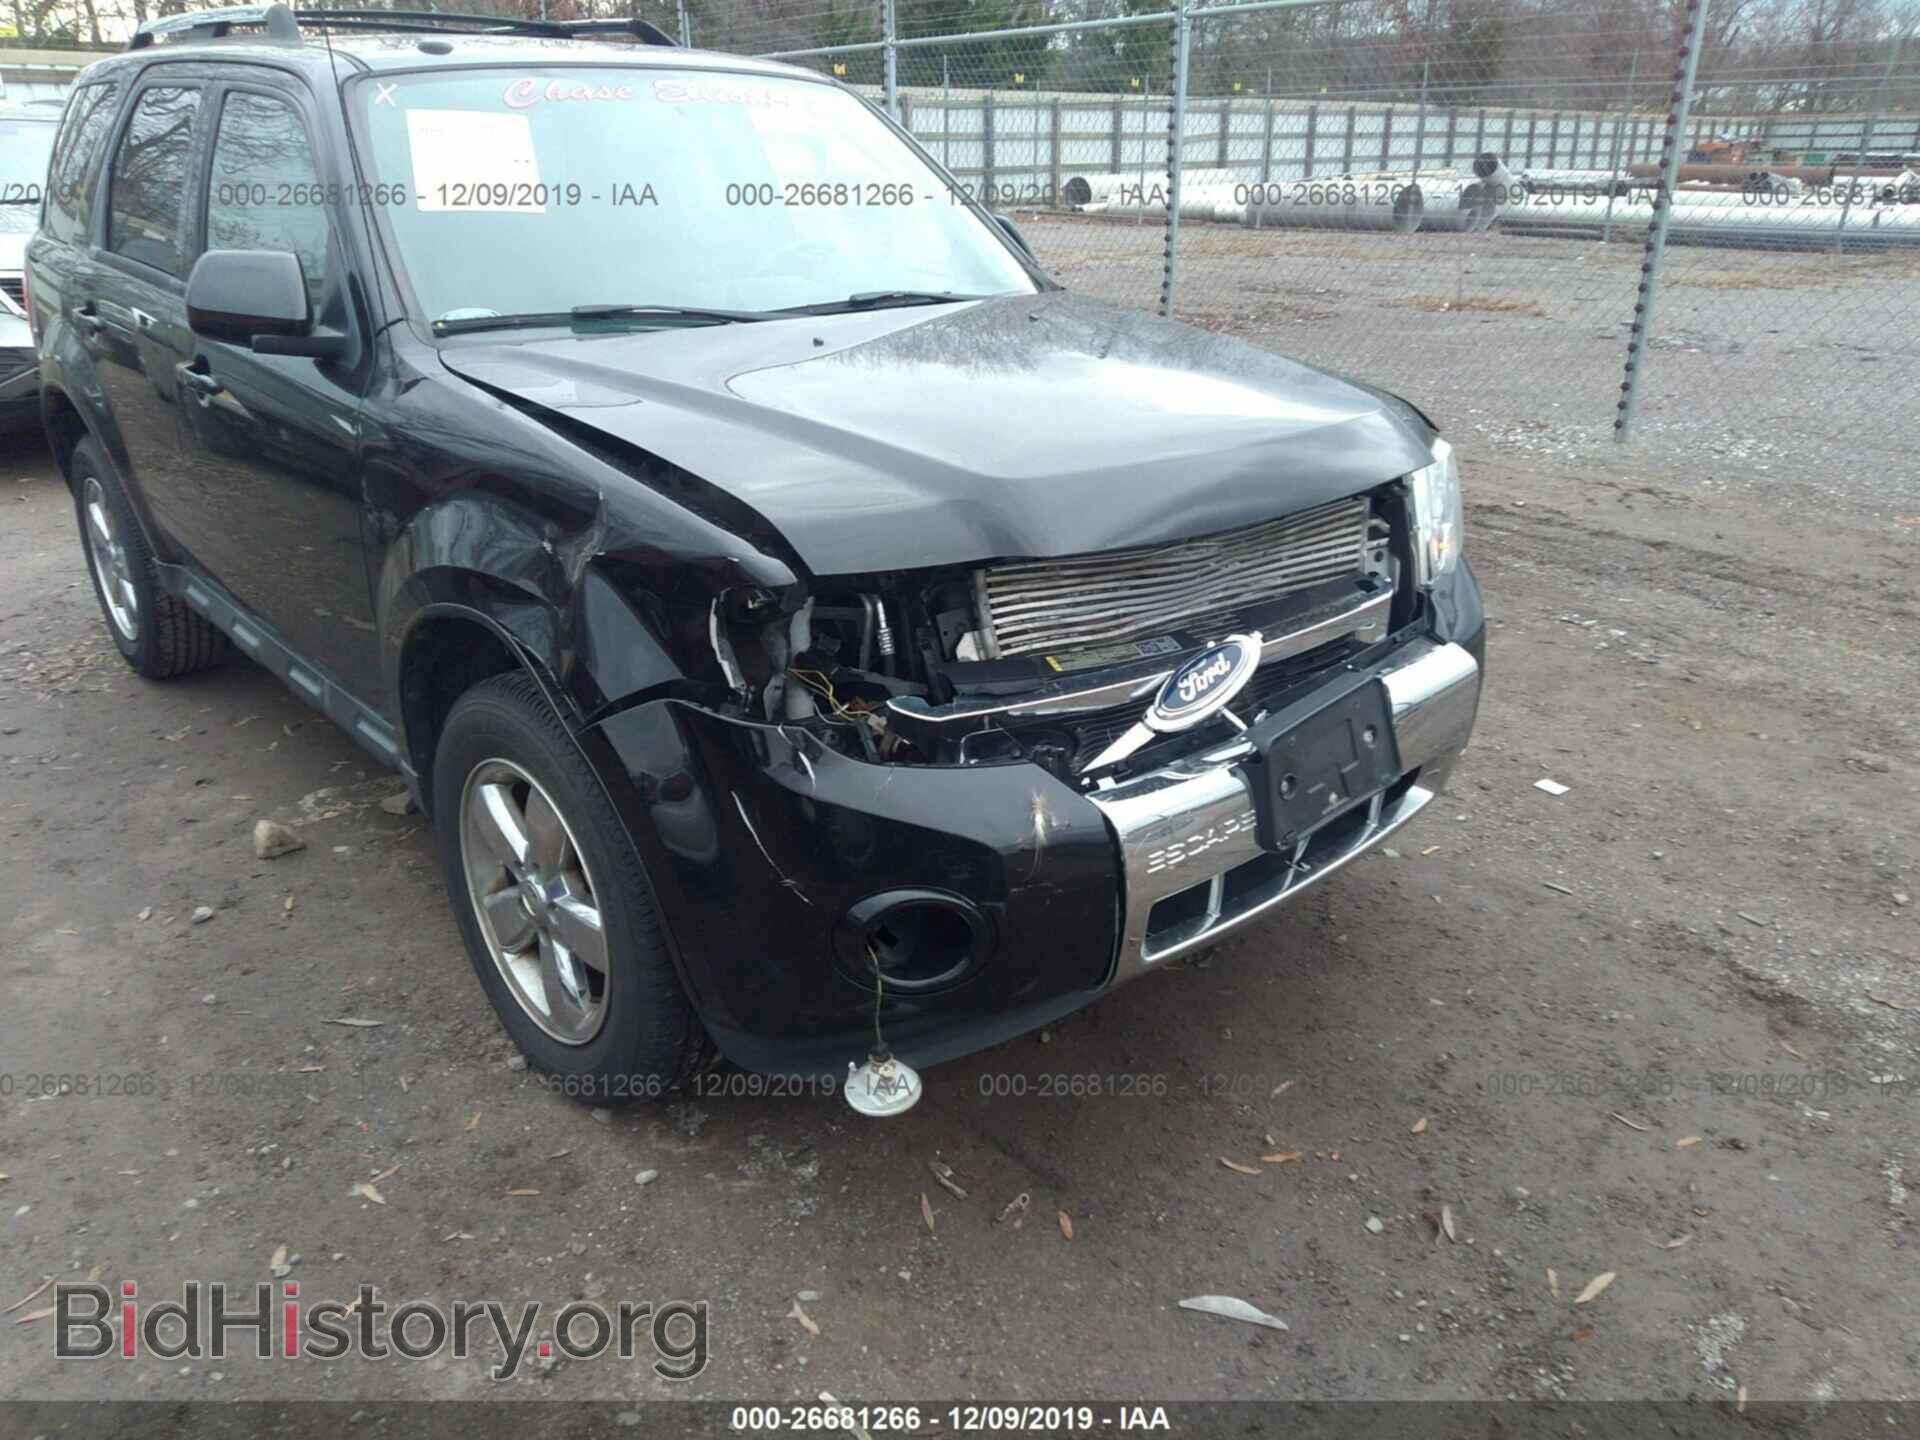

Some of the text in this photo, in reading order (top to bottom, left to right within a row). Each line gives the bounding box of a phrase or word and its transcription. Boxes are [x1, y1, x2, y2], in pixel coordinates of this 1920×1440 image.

[502, 78, 633, 109] Chase
[1177, 652, 1231, 701] Ford
[1146, 809, 1256, 874] ESCAPE
